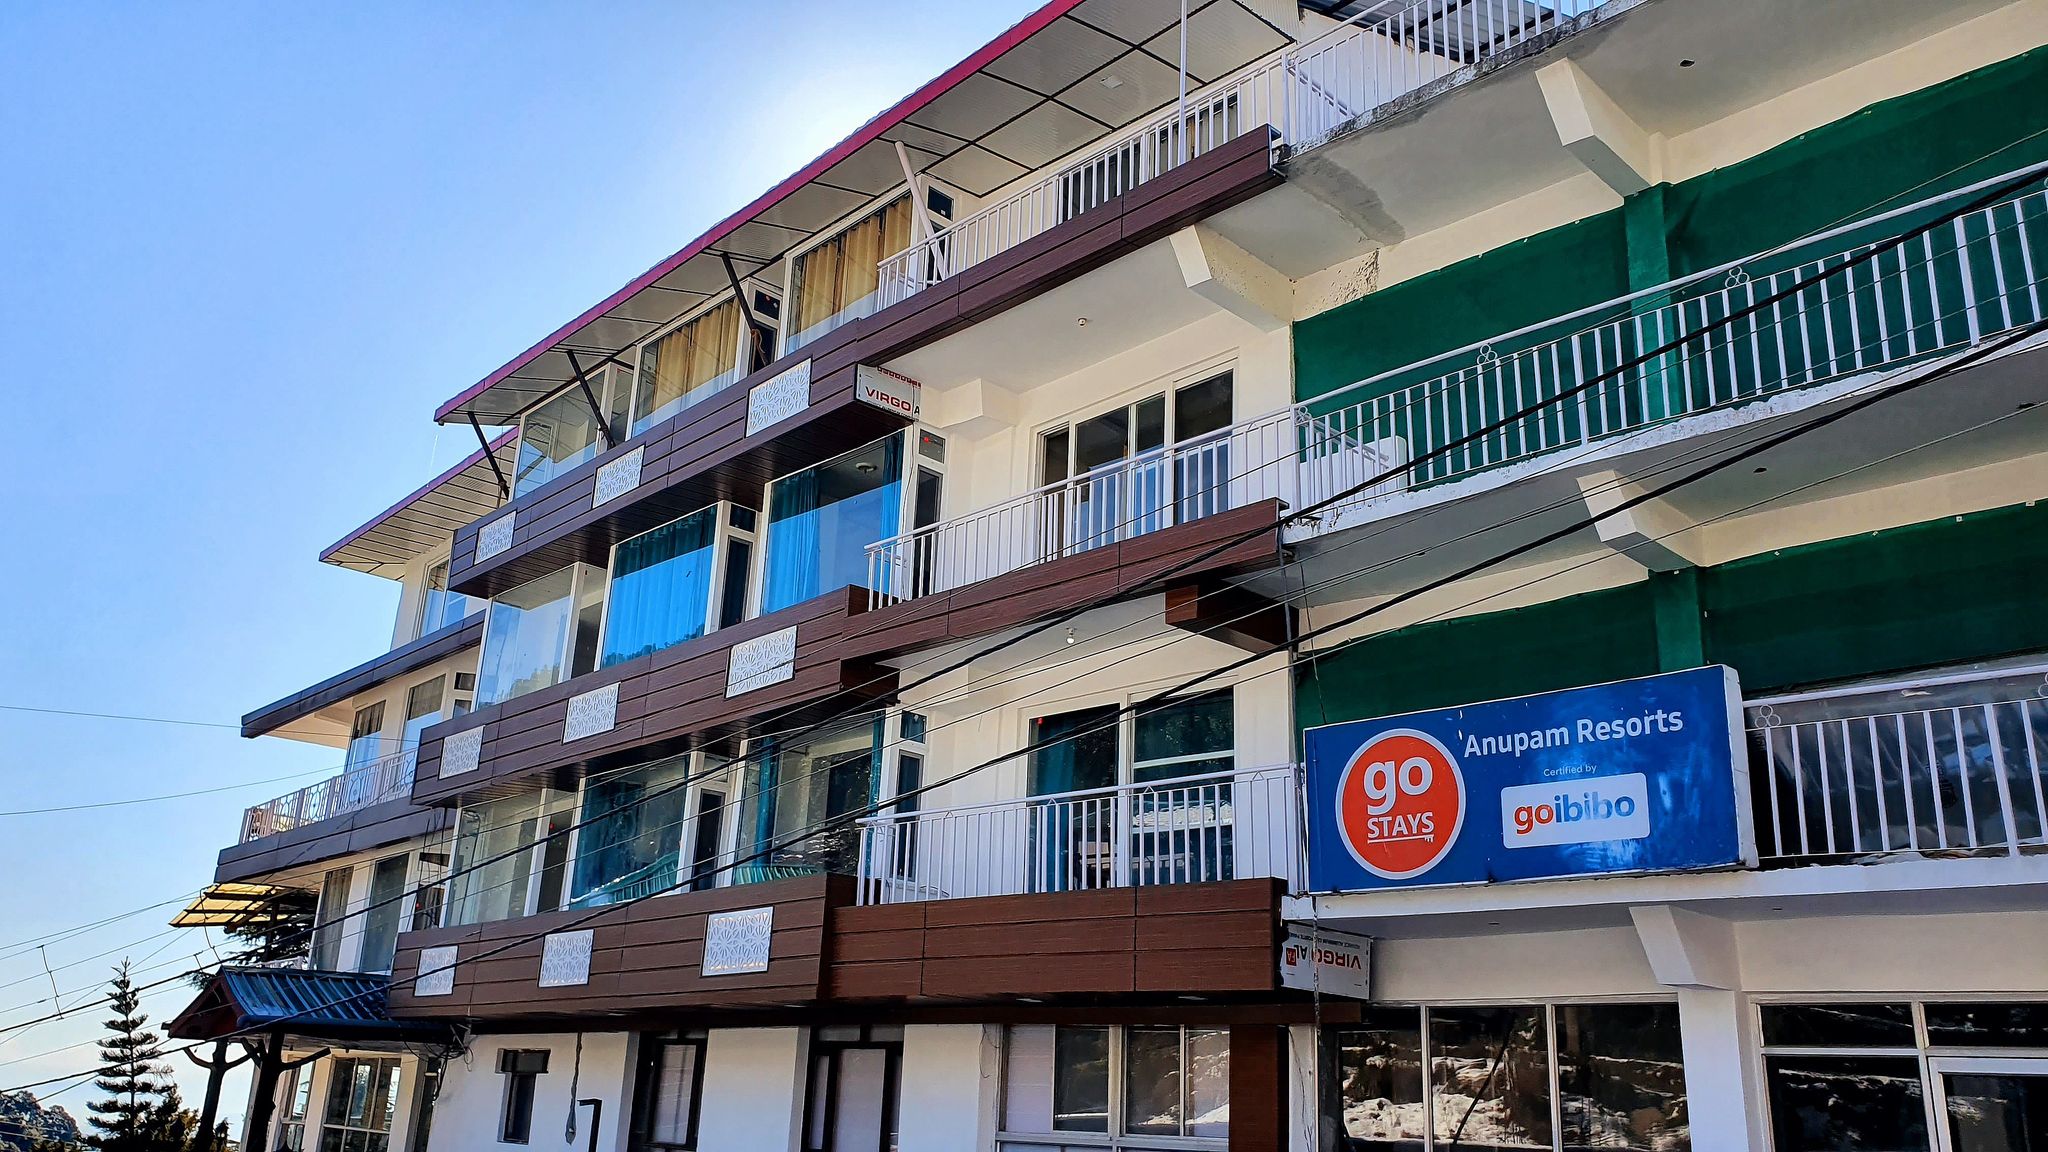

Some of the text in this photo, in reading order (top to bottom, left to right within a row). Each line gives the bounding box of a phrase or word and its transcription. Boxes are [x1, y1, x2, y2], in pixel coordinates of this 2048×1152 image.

[865, 386, 911, 412] VIRGO
[1464, 709, 1684, 758] Anupam Resorts
[1364, 756, 1433, 815] go
[1543, 763, 1597, 778] Certified by
[1367, 812, 1434, 838] STAYS
[1513, 792, 1635, 834] goibibo
